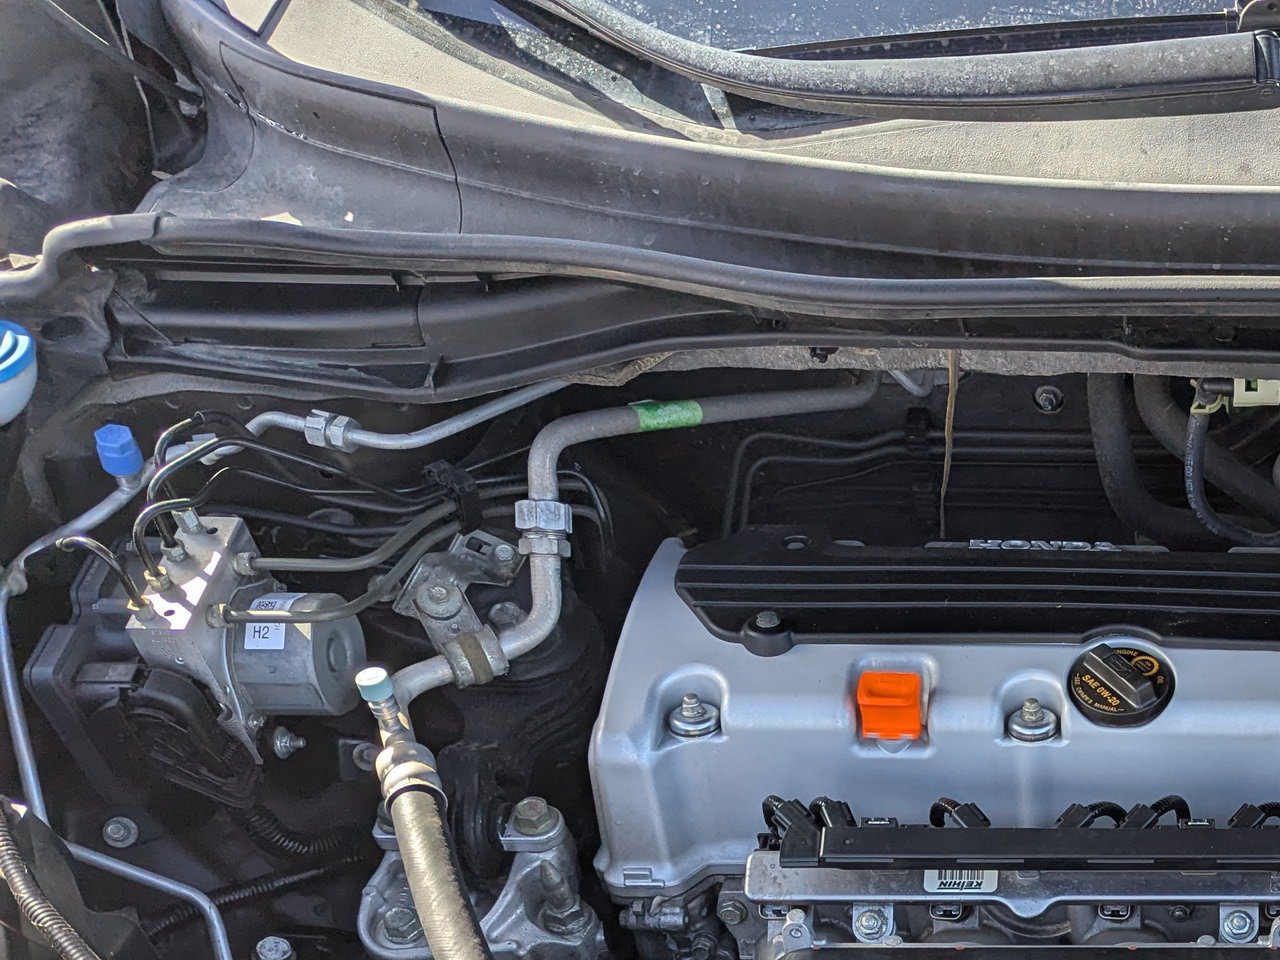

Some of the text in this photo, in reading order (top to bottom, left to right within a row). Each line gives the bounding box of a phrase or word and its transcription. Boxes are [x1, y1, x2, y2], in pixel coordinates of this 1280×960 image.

[968, 539, 1122, 552] HONDA
[252, 625, 270, 640] H2
[1082, 674, 1121, 707] SAE 0W-20
[937, 880, 983, 890] KEIHIN
